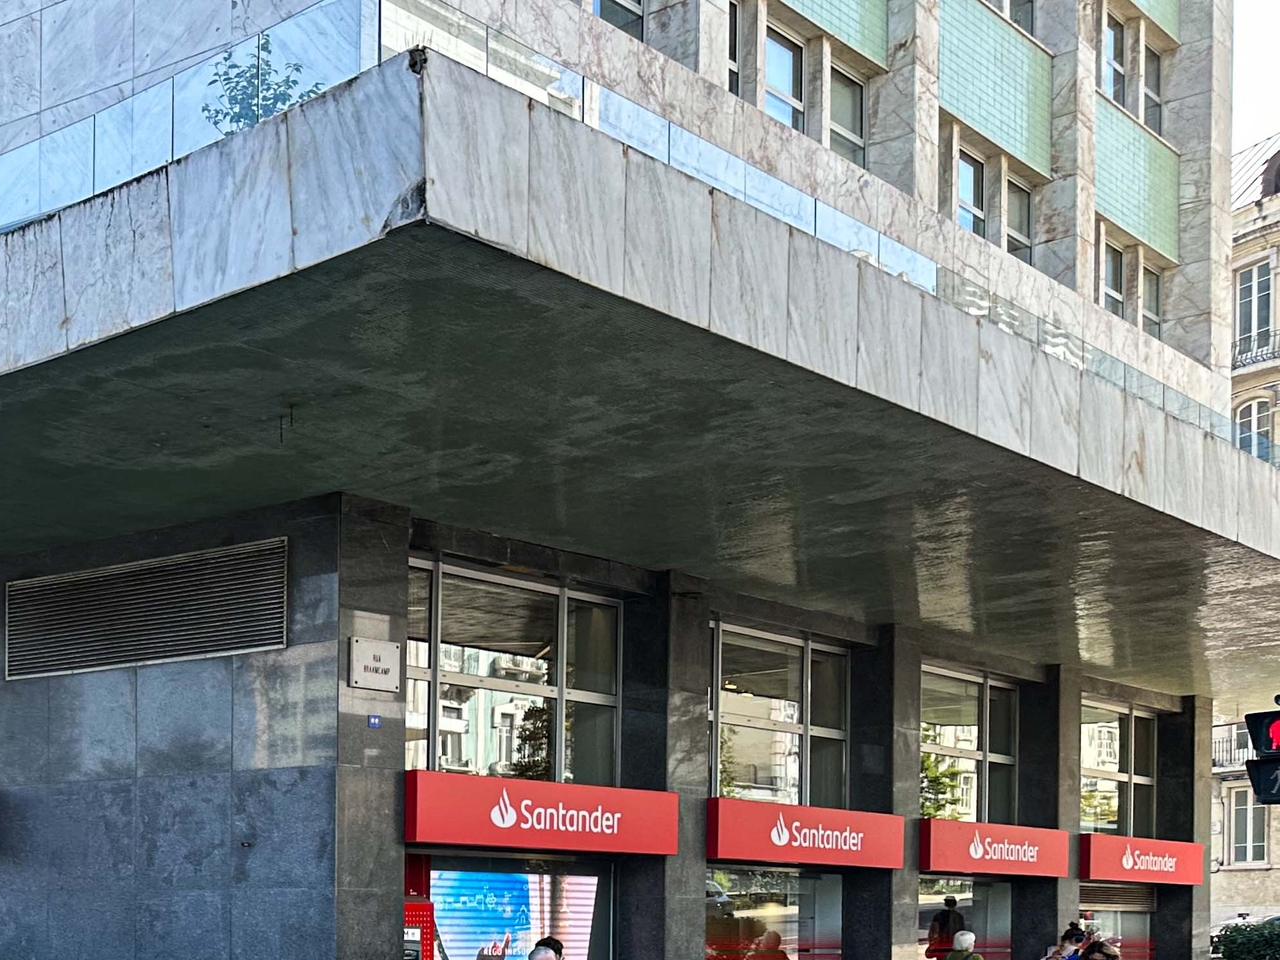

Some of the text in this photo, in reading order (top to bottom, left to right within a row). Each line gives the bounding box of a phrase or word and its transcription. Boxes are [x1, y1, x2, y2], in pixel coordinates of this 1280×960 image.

[373, 654, 381, 662] RUA
[520, 799, 621, 834] Santander
[791, 821, 864, 851] Santander
[984, 837, 1039, 862] Santander
[1134, 850, 1177, 872] Santander
